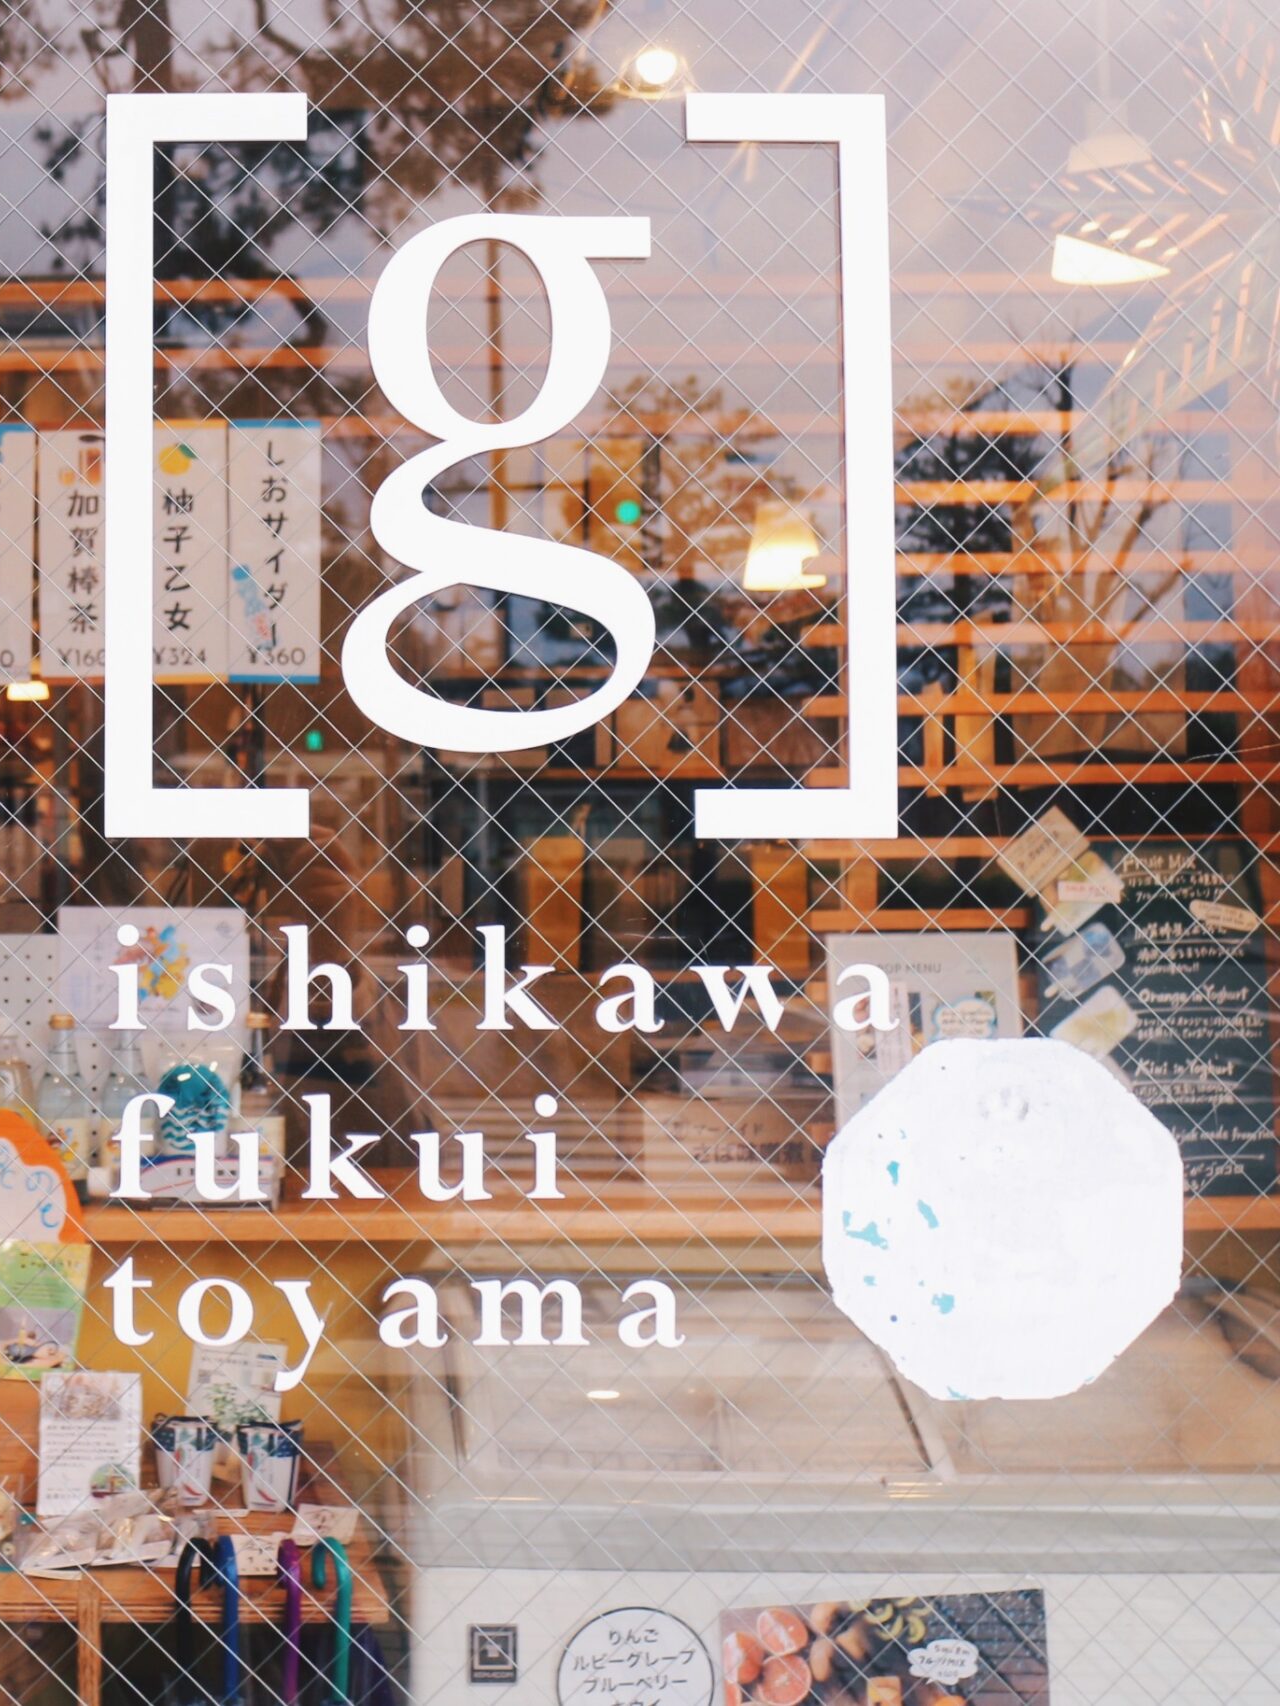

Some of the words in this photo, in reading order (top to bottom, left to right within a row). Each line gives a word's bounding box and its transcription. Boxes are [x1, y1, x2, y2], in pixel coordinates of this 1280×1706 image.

[67, 488, 100, 635] 加賀棒茶
[161, 488, 194, 632] 柚子乙女
[260, 439, 291, 647] しおサイダー
[246, 648, 306, 667] ¥360
[107, 925, 900, 1033] ishikawa
[905, 962, 942, 974] MENU
[111, 1092, 567, 1202] fukui
[102, 1256, 685, 1392] toyama
[608, 1628, 660, 1646] りんご
